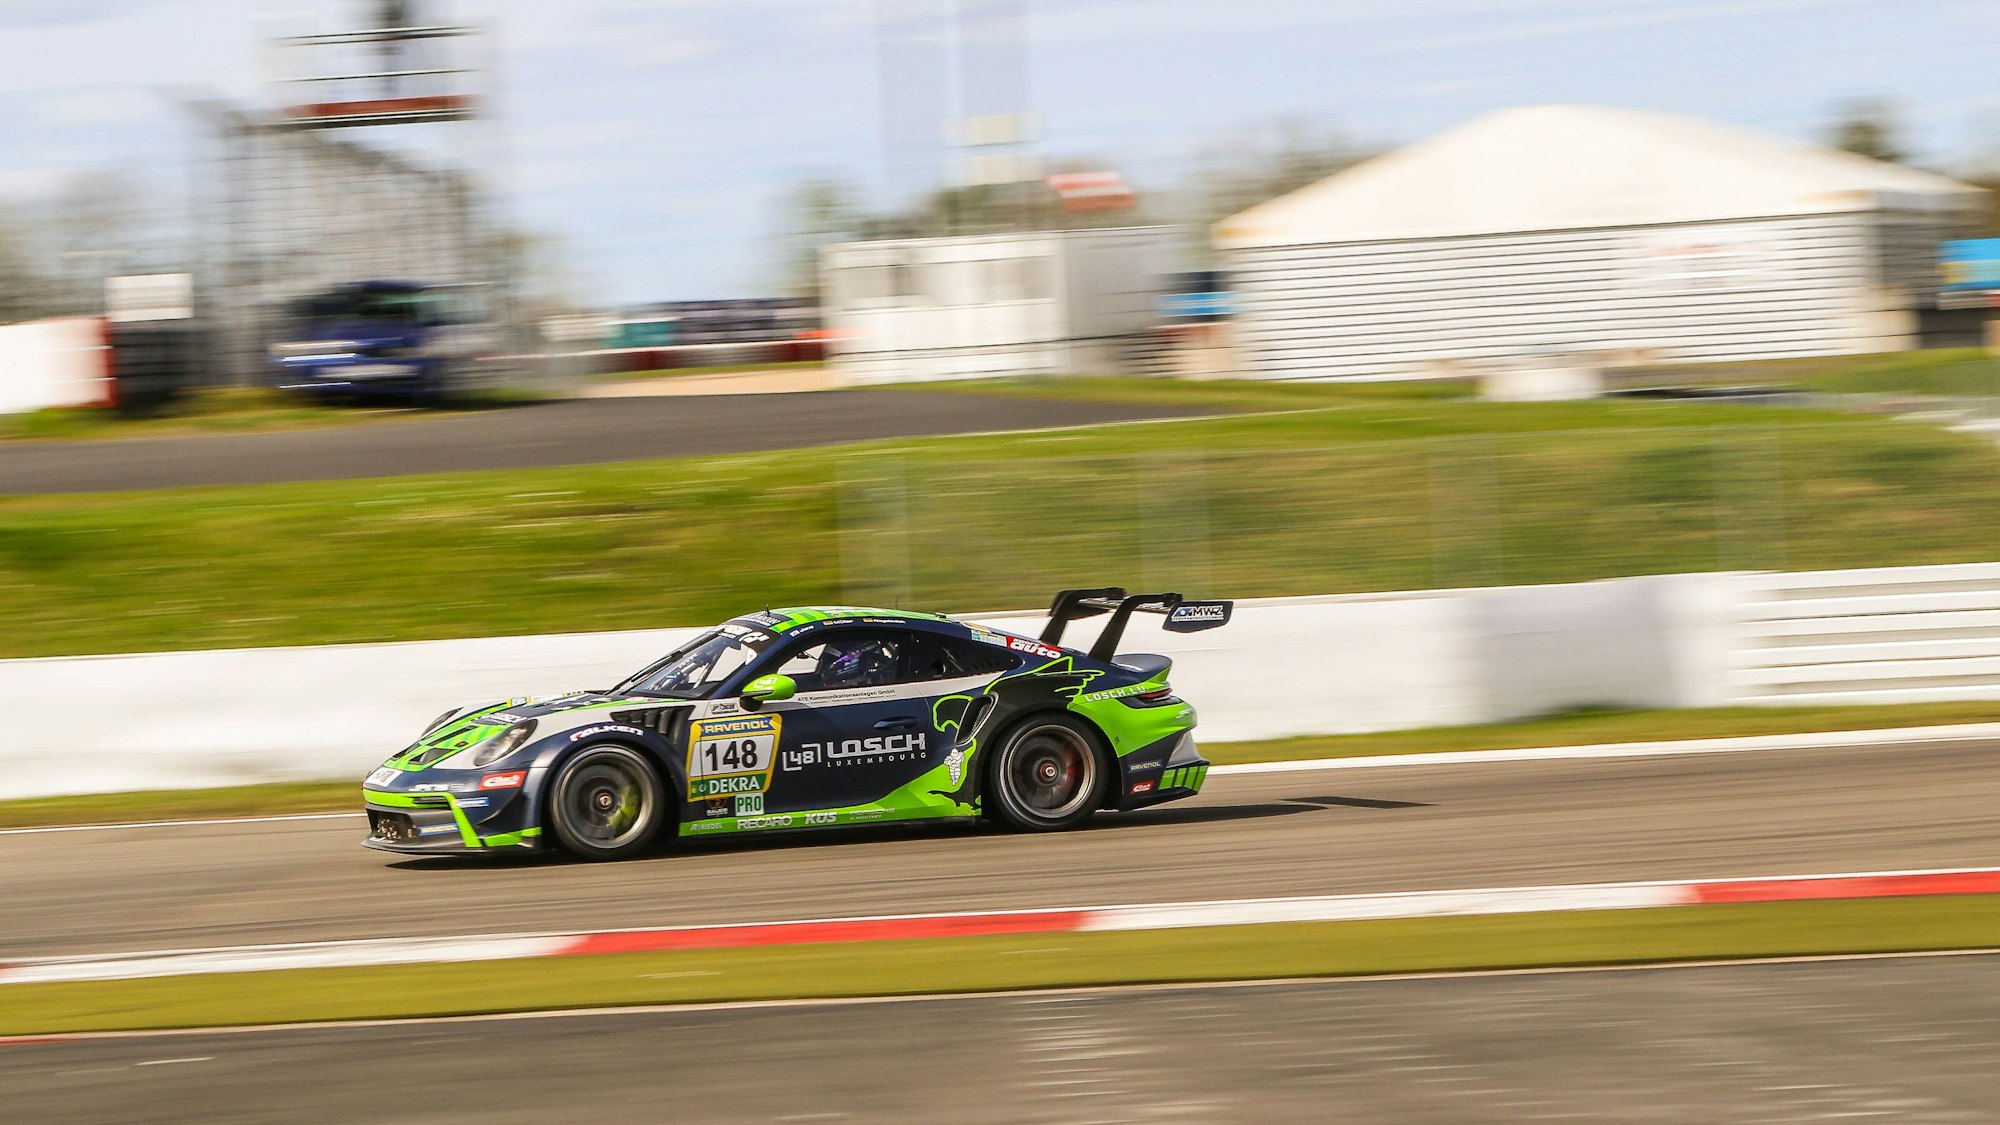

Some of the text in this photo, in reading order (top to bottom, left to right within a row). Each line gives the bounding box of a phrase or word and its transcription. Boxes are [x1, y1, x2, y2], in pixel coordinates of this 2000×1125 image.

[1010, 641, 1061, 659] auto
[1084, 686, 1146, 702] LOSCH.LU
[570, 724, 644, 742] FALKEN
[704, 720, 769, 733] RAVENOL
[827, 733, 926, 758] LOSCH
[705, 740, 758, 771] 148
[827, 753, 927, 768] LUXEMBOURG
[1130, 762, 1162, 771] RAVENOL
[709, 776, 760, 794] DEKRA
[737, 796, 762, 812] PRO
[737, 815, 793, 829] RECARO
